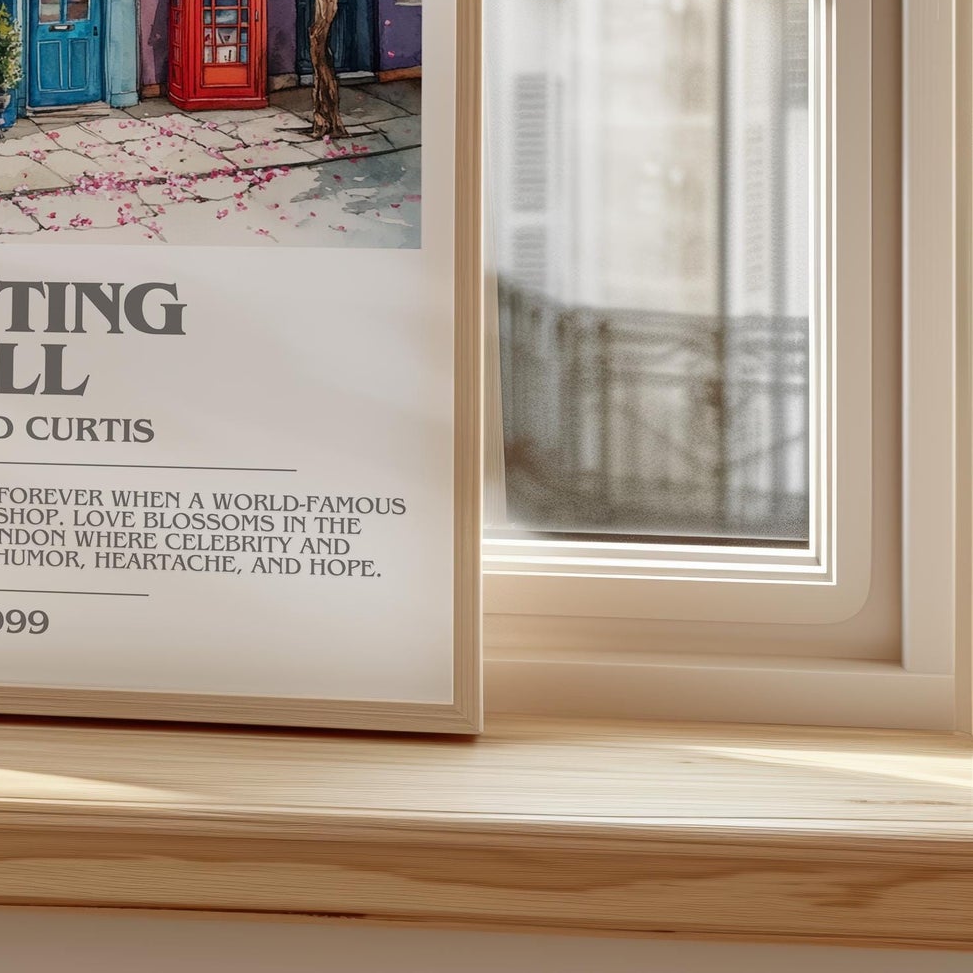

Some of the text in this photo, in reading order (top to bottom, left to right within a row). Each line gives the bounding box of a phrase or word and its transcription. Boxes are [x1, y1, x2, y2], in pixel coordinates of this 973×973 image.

[26, 416, 154, 443] CURTIS
[111, 490, 180, 508] WHEN
[188, 492, 204, 509] A
[212, 493, 406, 515] WORLD-FAMOUS
[73, 510, 136, 528] LOVE
[143, 512, 274, 532] BLOSSOMS
[283, 516, 306, 533] IN
[314, 517, 362, 535] THE
[75, 530, 158, 549] WHERE
[165, 533, 293, 553] CELEBRITY
[299, 537, 350, 555] AND
[95, 552, 242, 574] HEARTACHE,
[251, 557, 301, 574] AND
[310, 558, 381, 577] HOPE.
